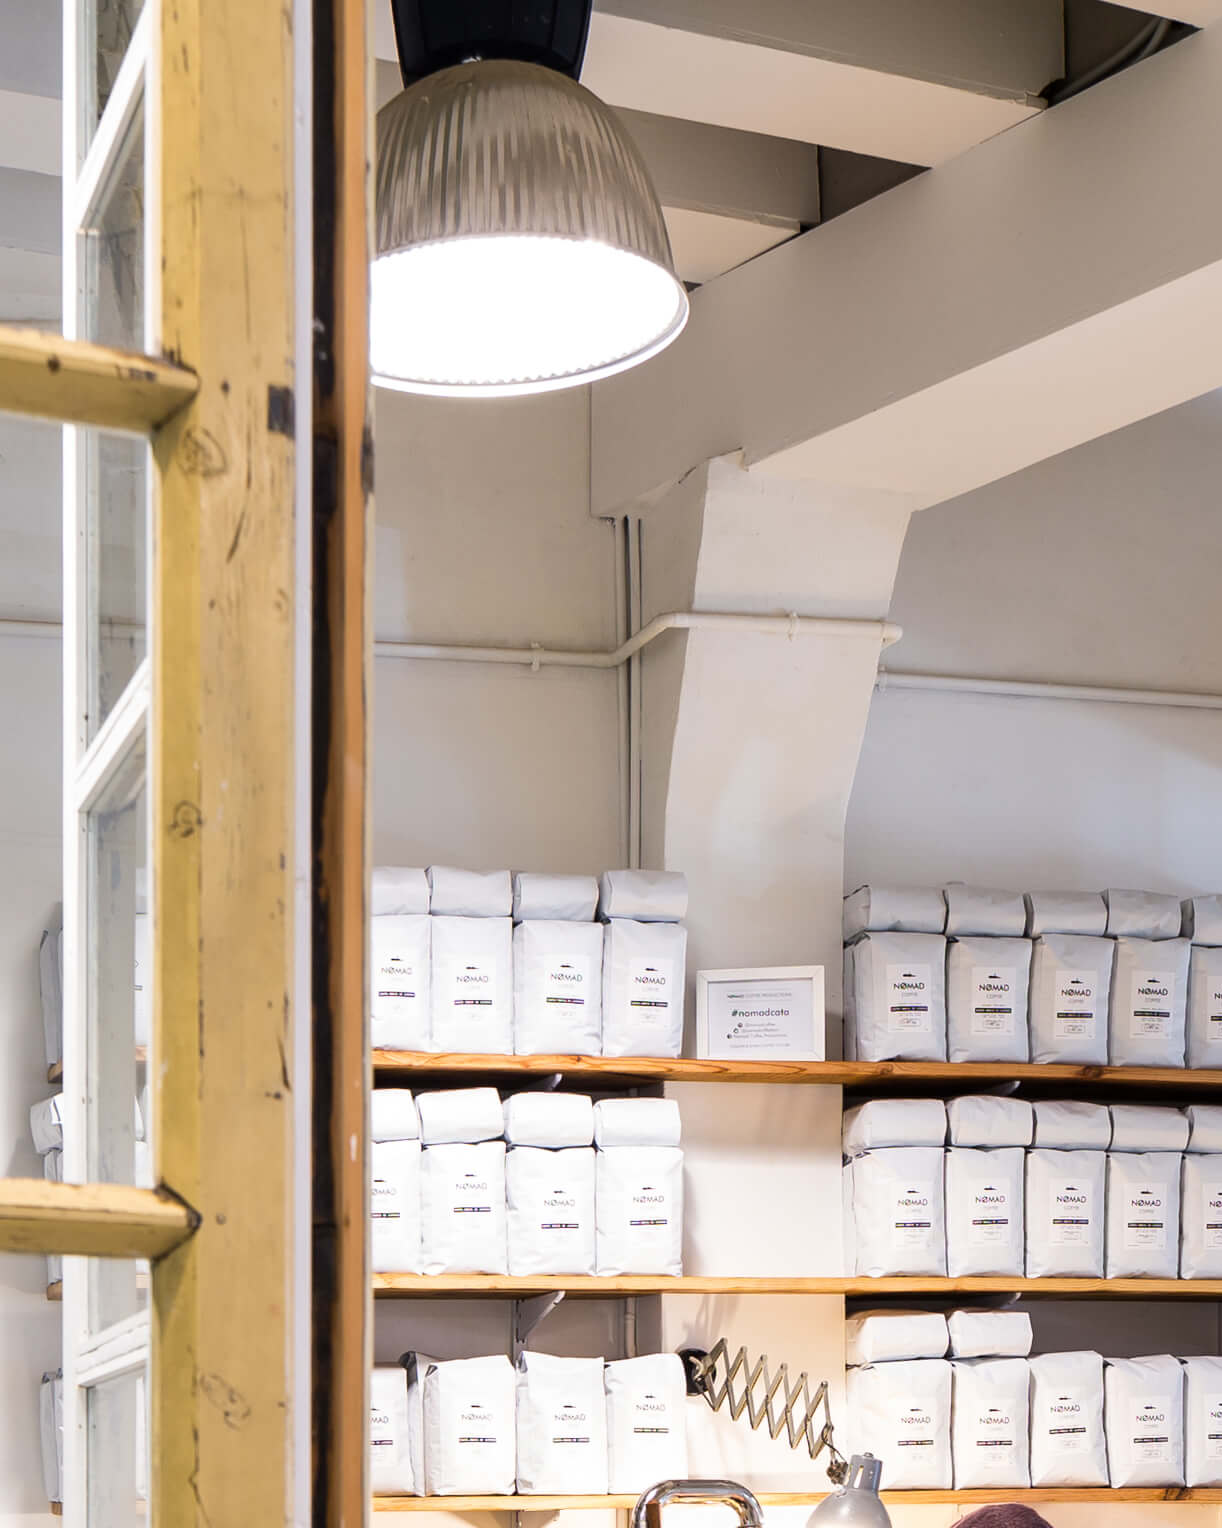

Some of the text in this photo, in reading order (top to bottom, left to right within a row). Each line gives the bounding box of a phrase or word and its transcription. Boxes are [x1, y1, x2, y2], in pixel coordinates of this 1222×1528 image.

[551, 973, 583, 982] NØMAD
[635, 977, 666, 985] NØMAD
[1061, 989, 1091, 997] NØMAD
[1138, 988, 1168, 996] NØMAD
[731, 1008, 790, 1017] #nomadcata
[975, 1195, 1005, 1203] NØMAD
[1050, 1405, 1080, 1413] NØMAD
[901, 1416, 931, 1424] NØMAD
[979, 1416, 1009, 1425] NØMAD
[1136, 1414, 1164, 1422] NØMAD
